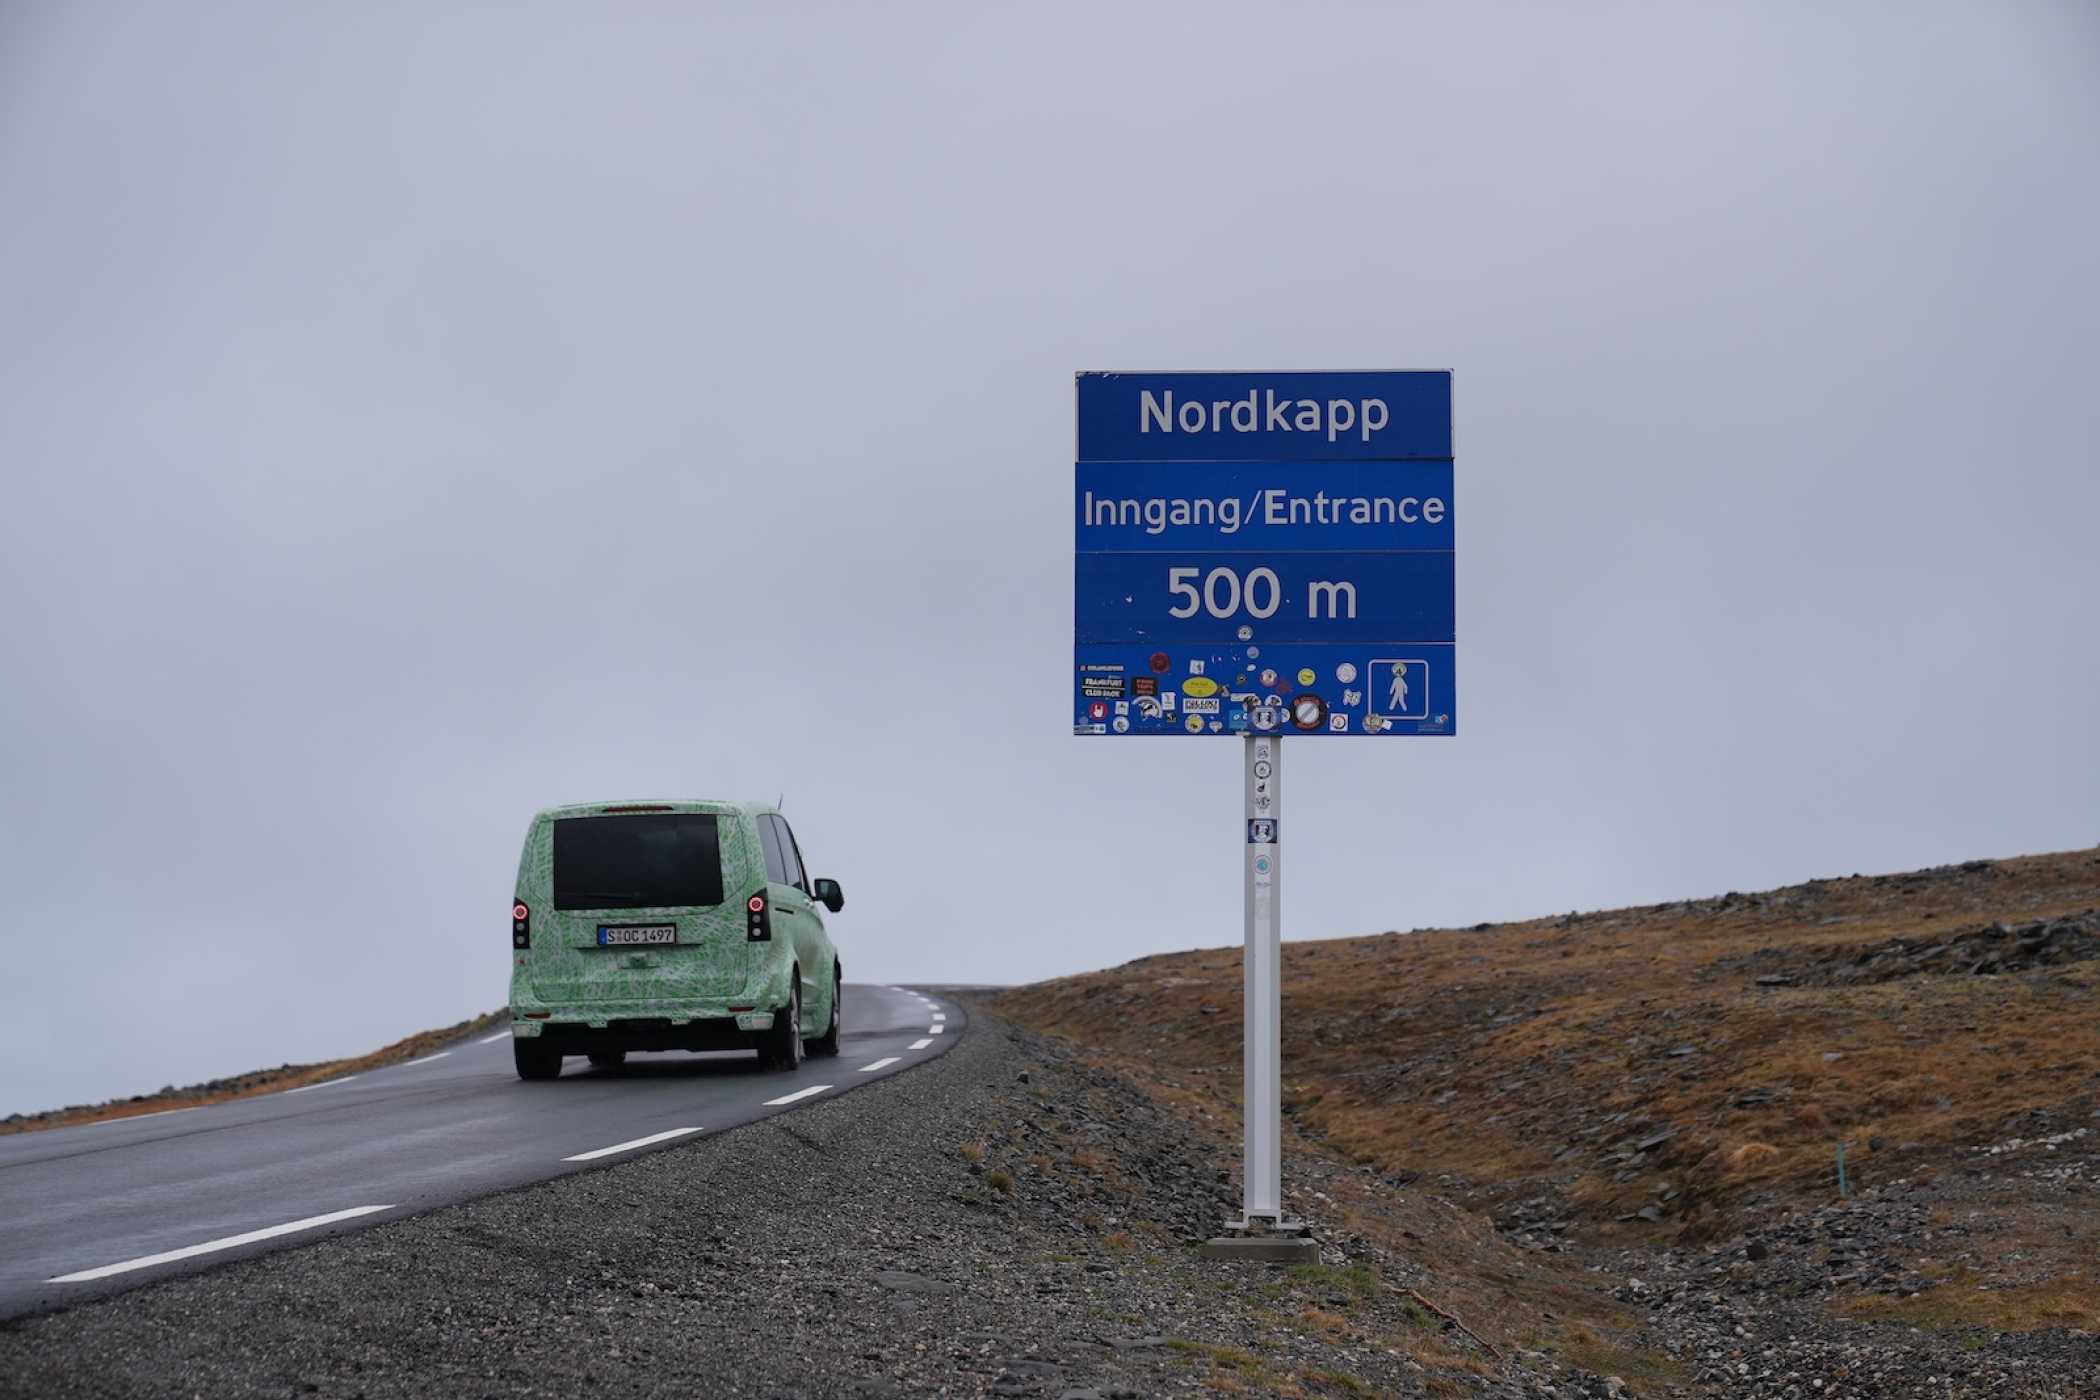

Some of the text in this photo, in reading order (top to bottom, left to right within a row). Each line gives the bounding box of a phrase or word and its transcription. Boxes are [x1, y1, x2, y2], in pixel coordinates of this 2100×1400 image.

[1140, 389, 1390, 442] Nordkapp
[1085, 489, 1446, 535] Inngang/Entrance
[1168, 567, 1357, 619] 500 m
[607, 928, 672, 943] S OC 1497
